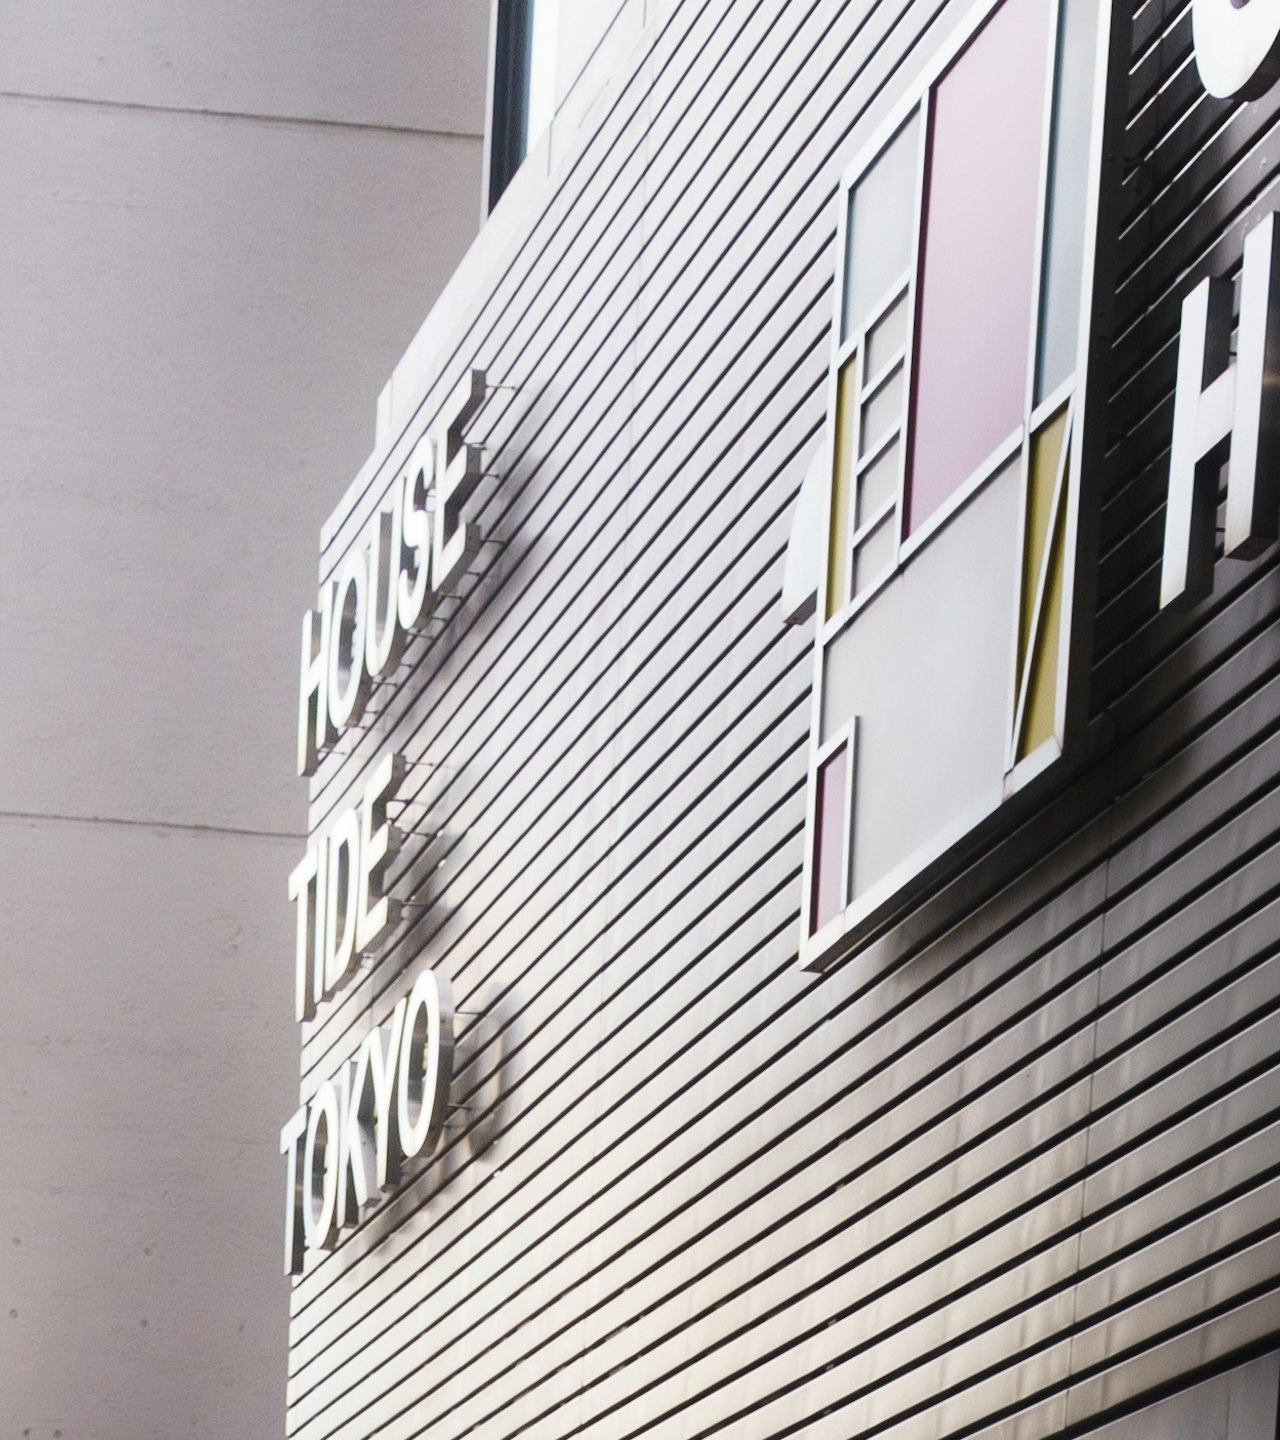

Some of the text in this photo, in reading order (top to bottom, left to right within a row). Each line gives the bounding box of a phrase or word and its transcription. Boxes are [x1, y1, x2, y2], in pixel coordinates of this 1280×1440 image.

[297, 369, 487, 778] HOUSE
[287, 751, 407, 1021] TIDE
[279, 968, 453, 1276] TOKYO
